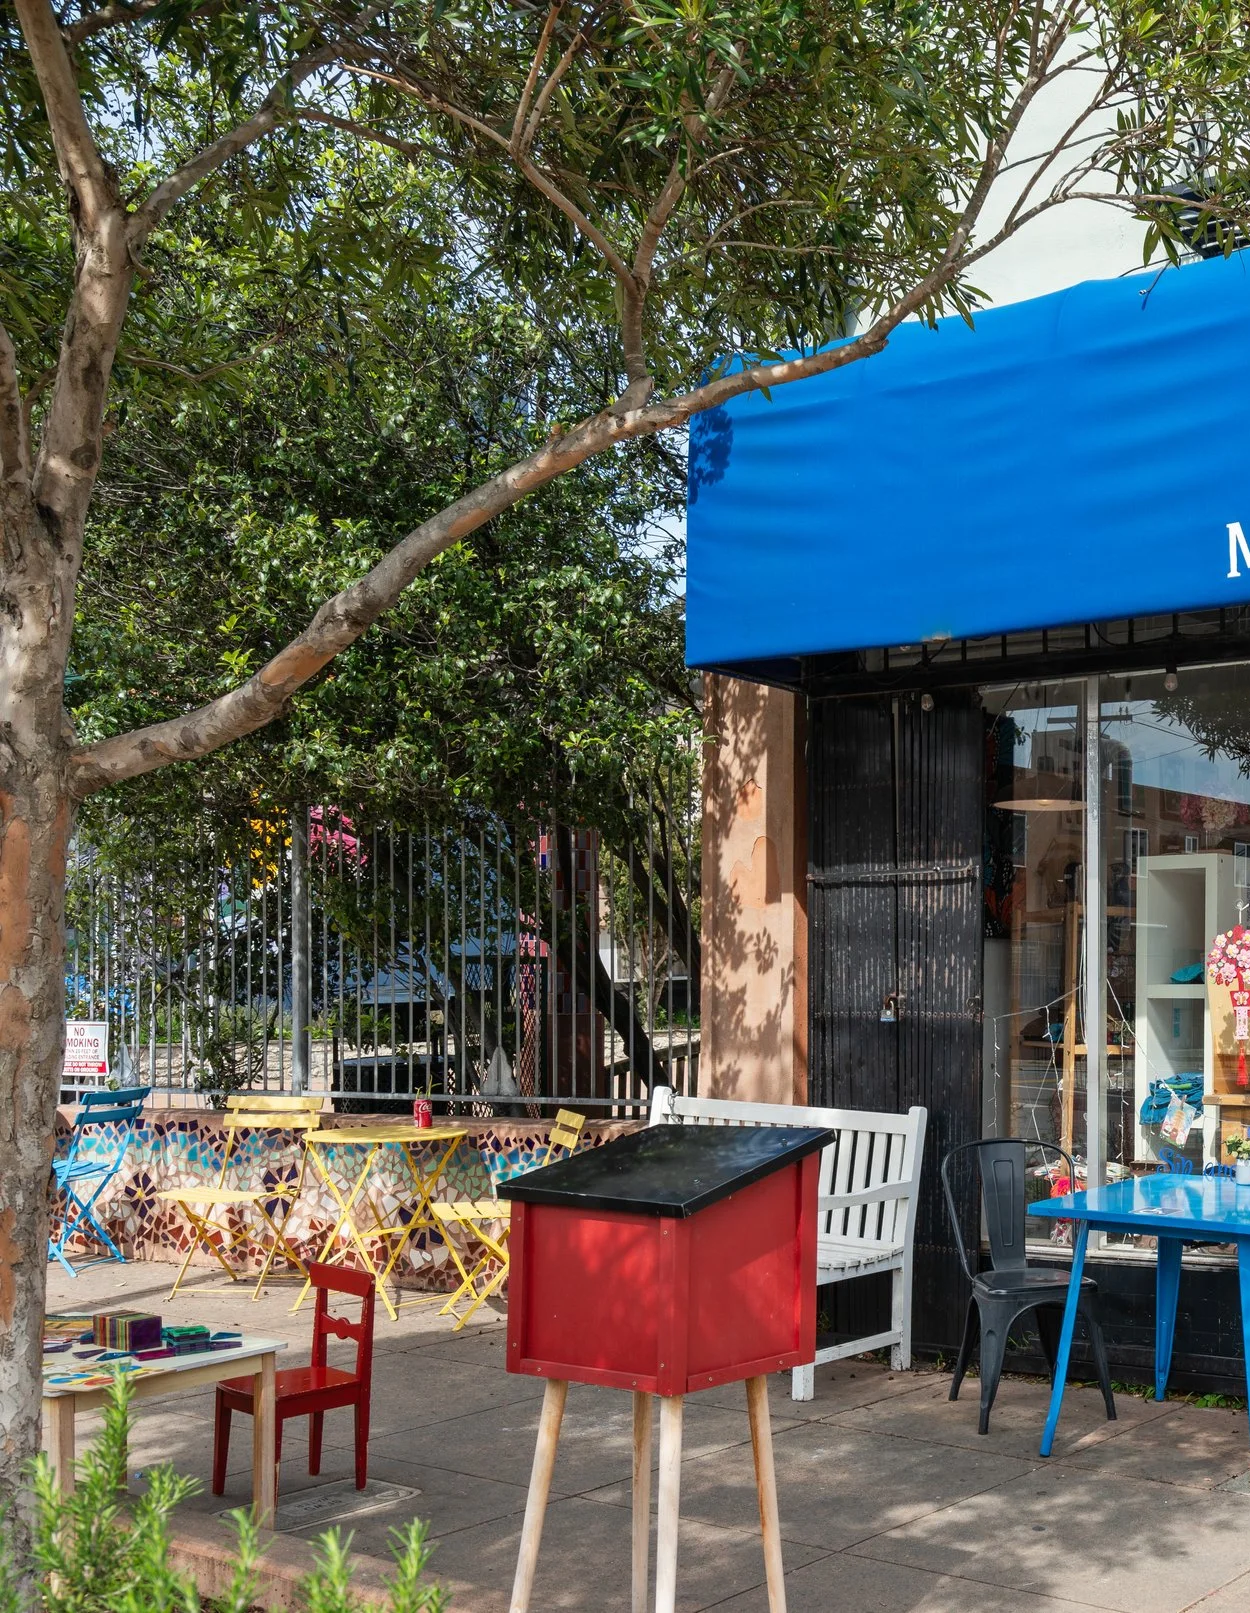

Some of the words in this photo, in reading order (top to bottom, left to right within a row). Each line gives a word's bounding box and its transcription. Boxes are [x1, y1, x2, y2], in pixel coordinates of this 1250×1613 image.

[74, 1027, 85, 1036] NO
[66, 1038, 99, 1048] MOKING
[1203, 1161, 1237, 1181] an
